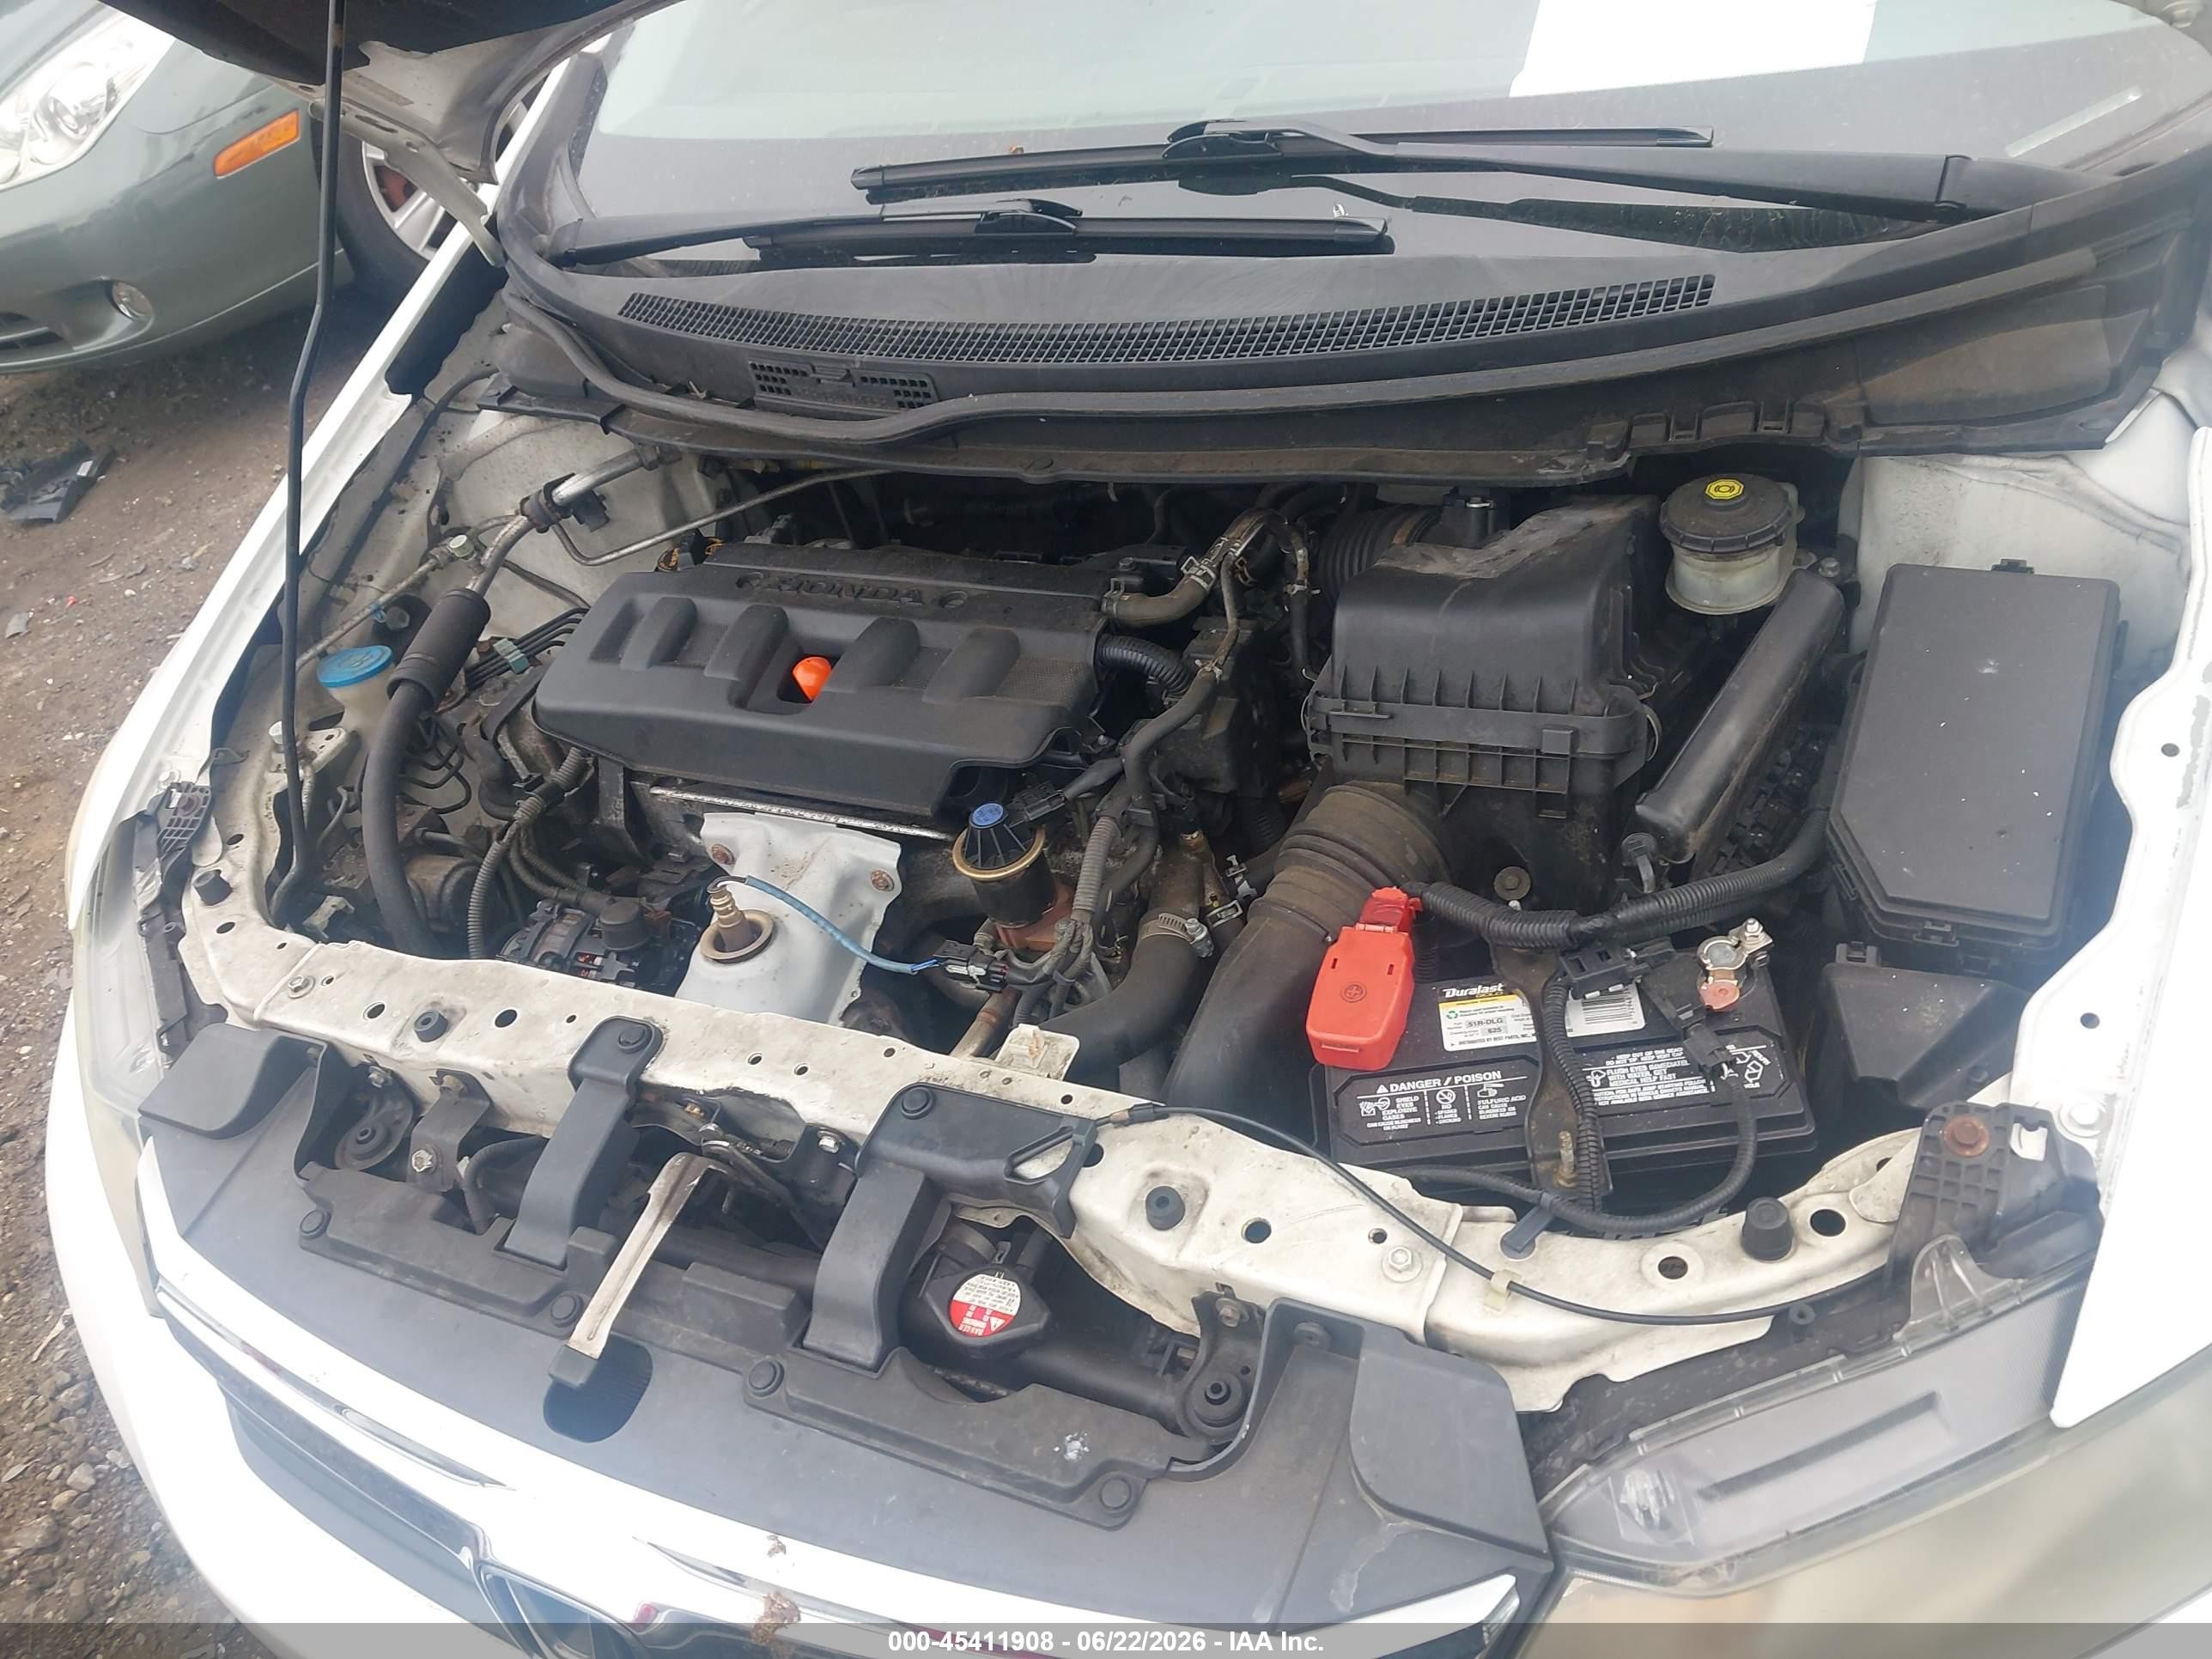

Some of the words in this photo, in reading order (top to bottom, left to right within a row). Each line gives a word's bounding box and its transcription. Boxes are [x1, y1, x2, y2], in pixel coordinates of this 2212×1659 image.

[772, 574, 925, 606] HONDA
[1443, 982, 1504, 998] Duralast
[1649, 1060, 1690, 1070] IMMEDIATEL
[1389, 1078, 1442, 1093] DANGER
[1455, 1071, 1502, 1085] POISON
[1477, 1097, 1510, 1105] SULFURIC
[1382, 1106, 1418, 1115] EXPLOSIVE
